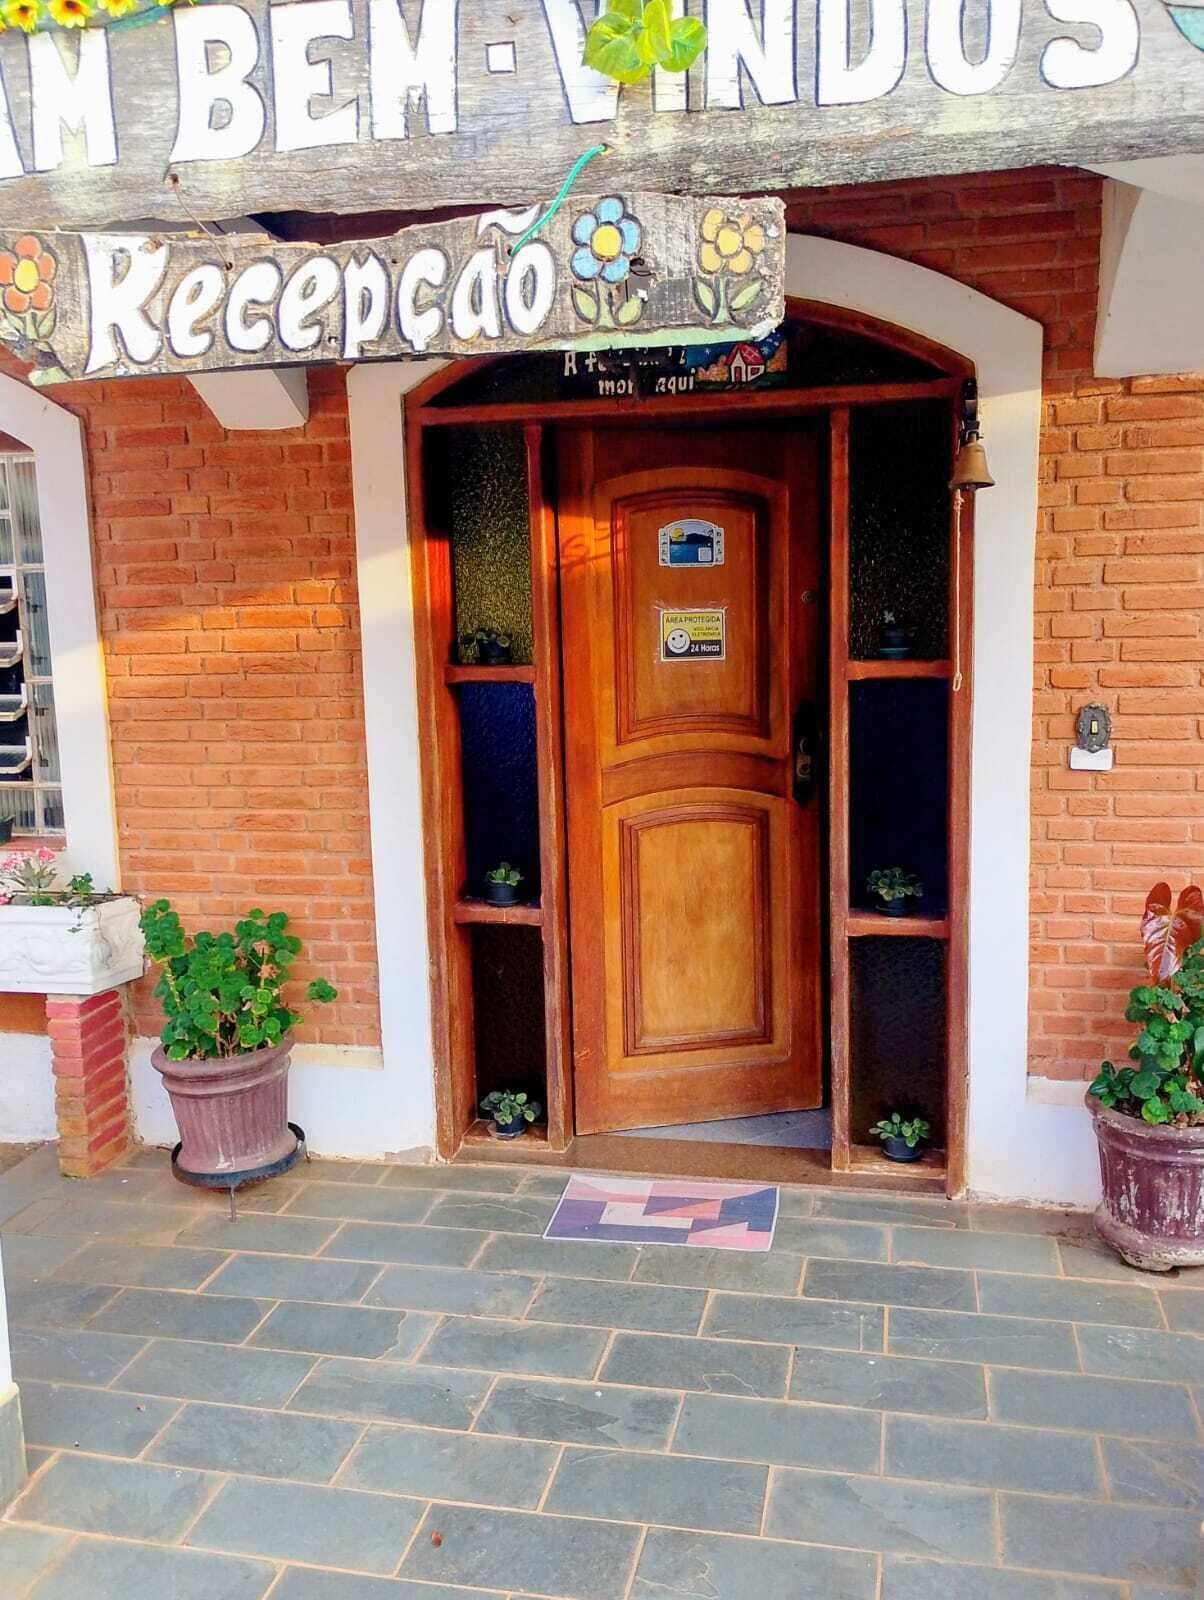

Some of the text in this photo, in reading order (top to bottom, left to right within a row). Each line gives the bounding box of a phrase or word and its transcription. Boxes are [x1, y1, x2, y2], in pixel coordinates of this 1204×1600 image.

[83, 203, 557, 375] Recepção
[598, 367, 695, 396] mor aqui
[684, 614, 720, 623] PROTEGIDA
[690, 644, 720, 653] 24 Horas
